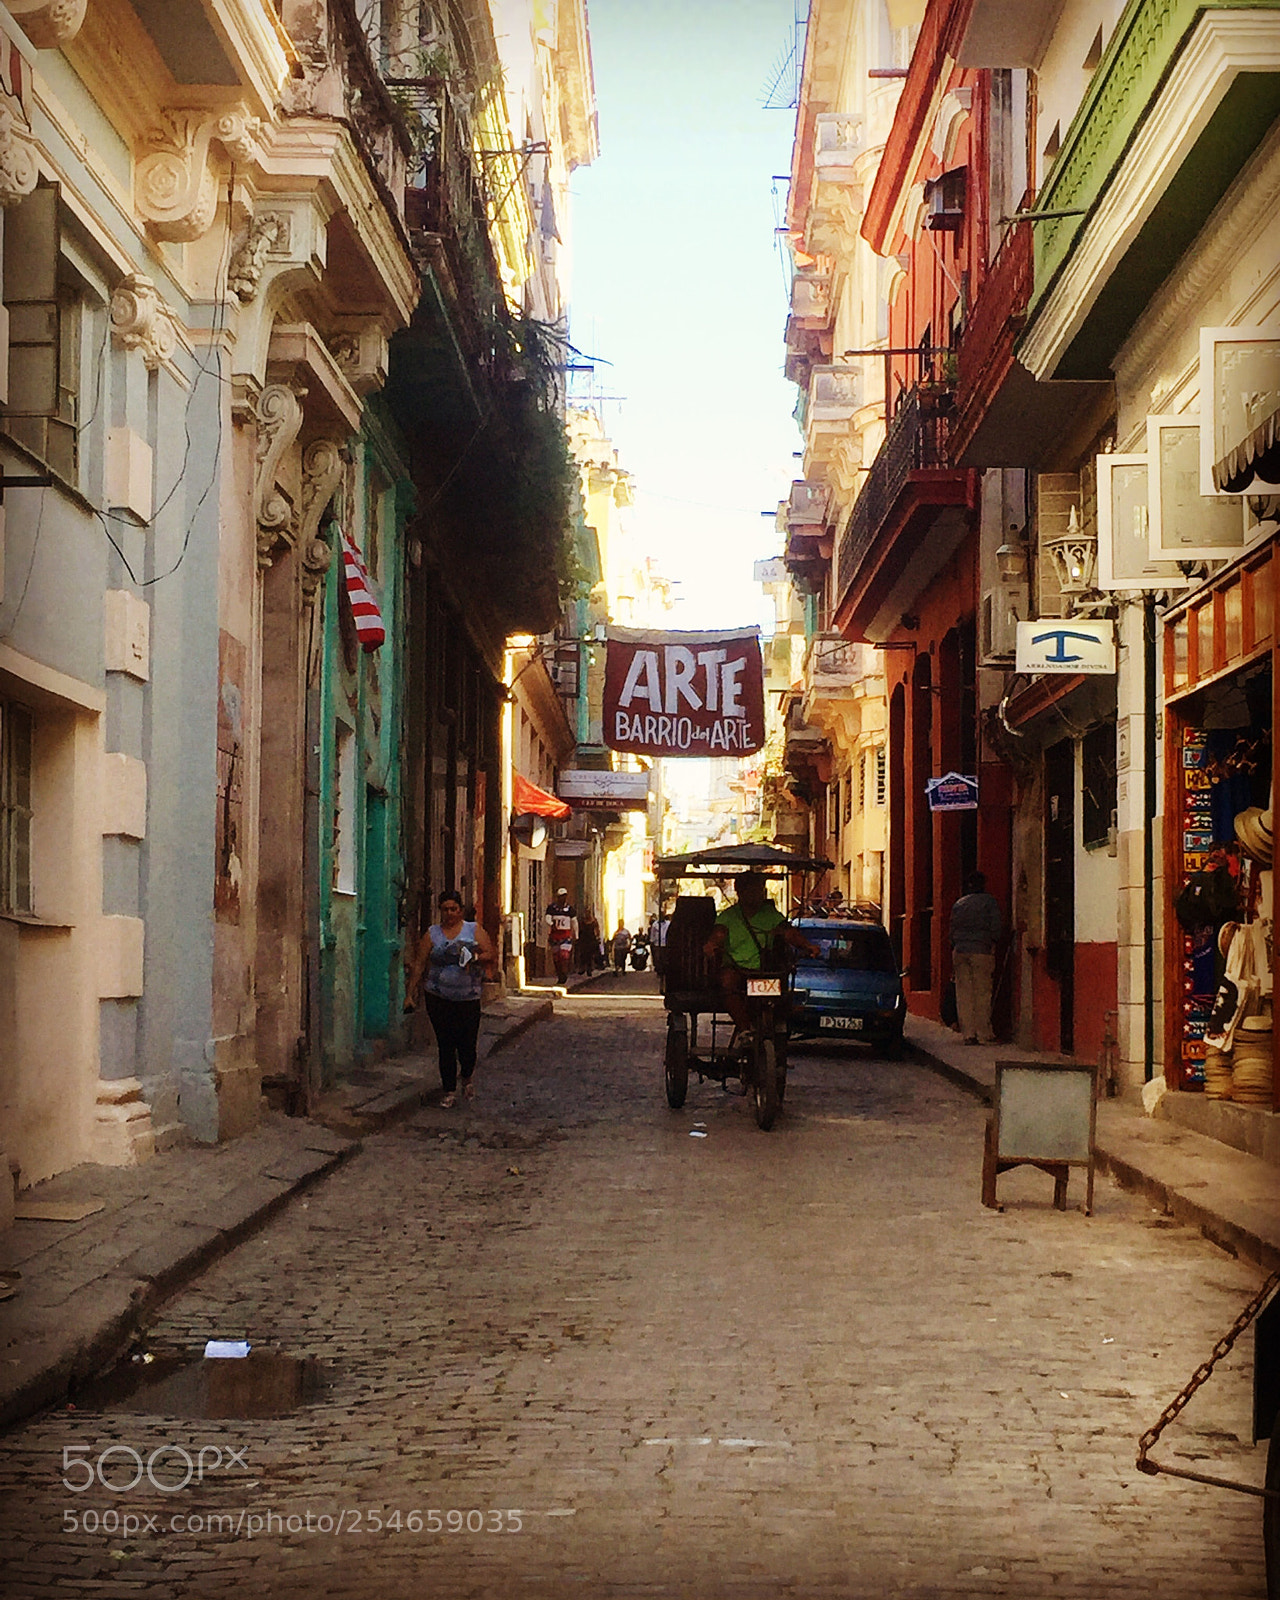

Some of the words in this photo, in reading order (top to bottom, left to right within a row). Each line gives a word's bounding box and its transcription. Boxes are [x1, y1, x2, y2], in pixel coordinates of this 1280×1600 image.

[618, 645, 747, 718] ARTE
[615, 711, 692, 749] BARRIO
[691, 726, 710, 742] del
[710, 719, 756, 750] ARTE
